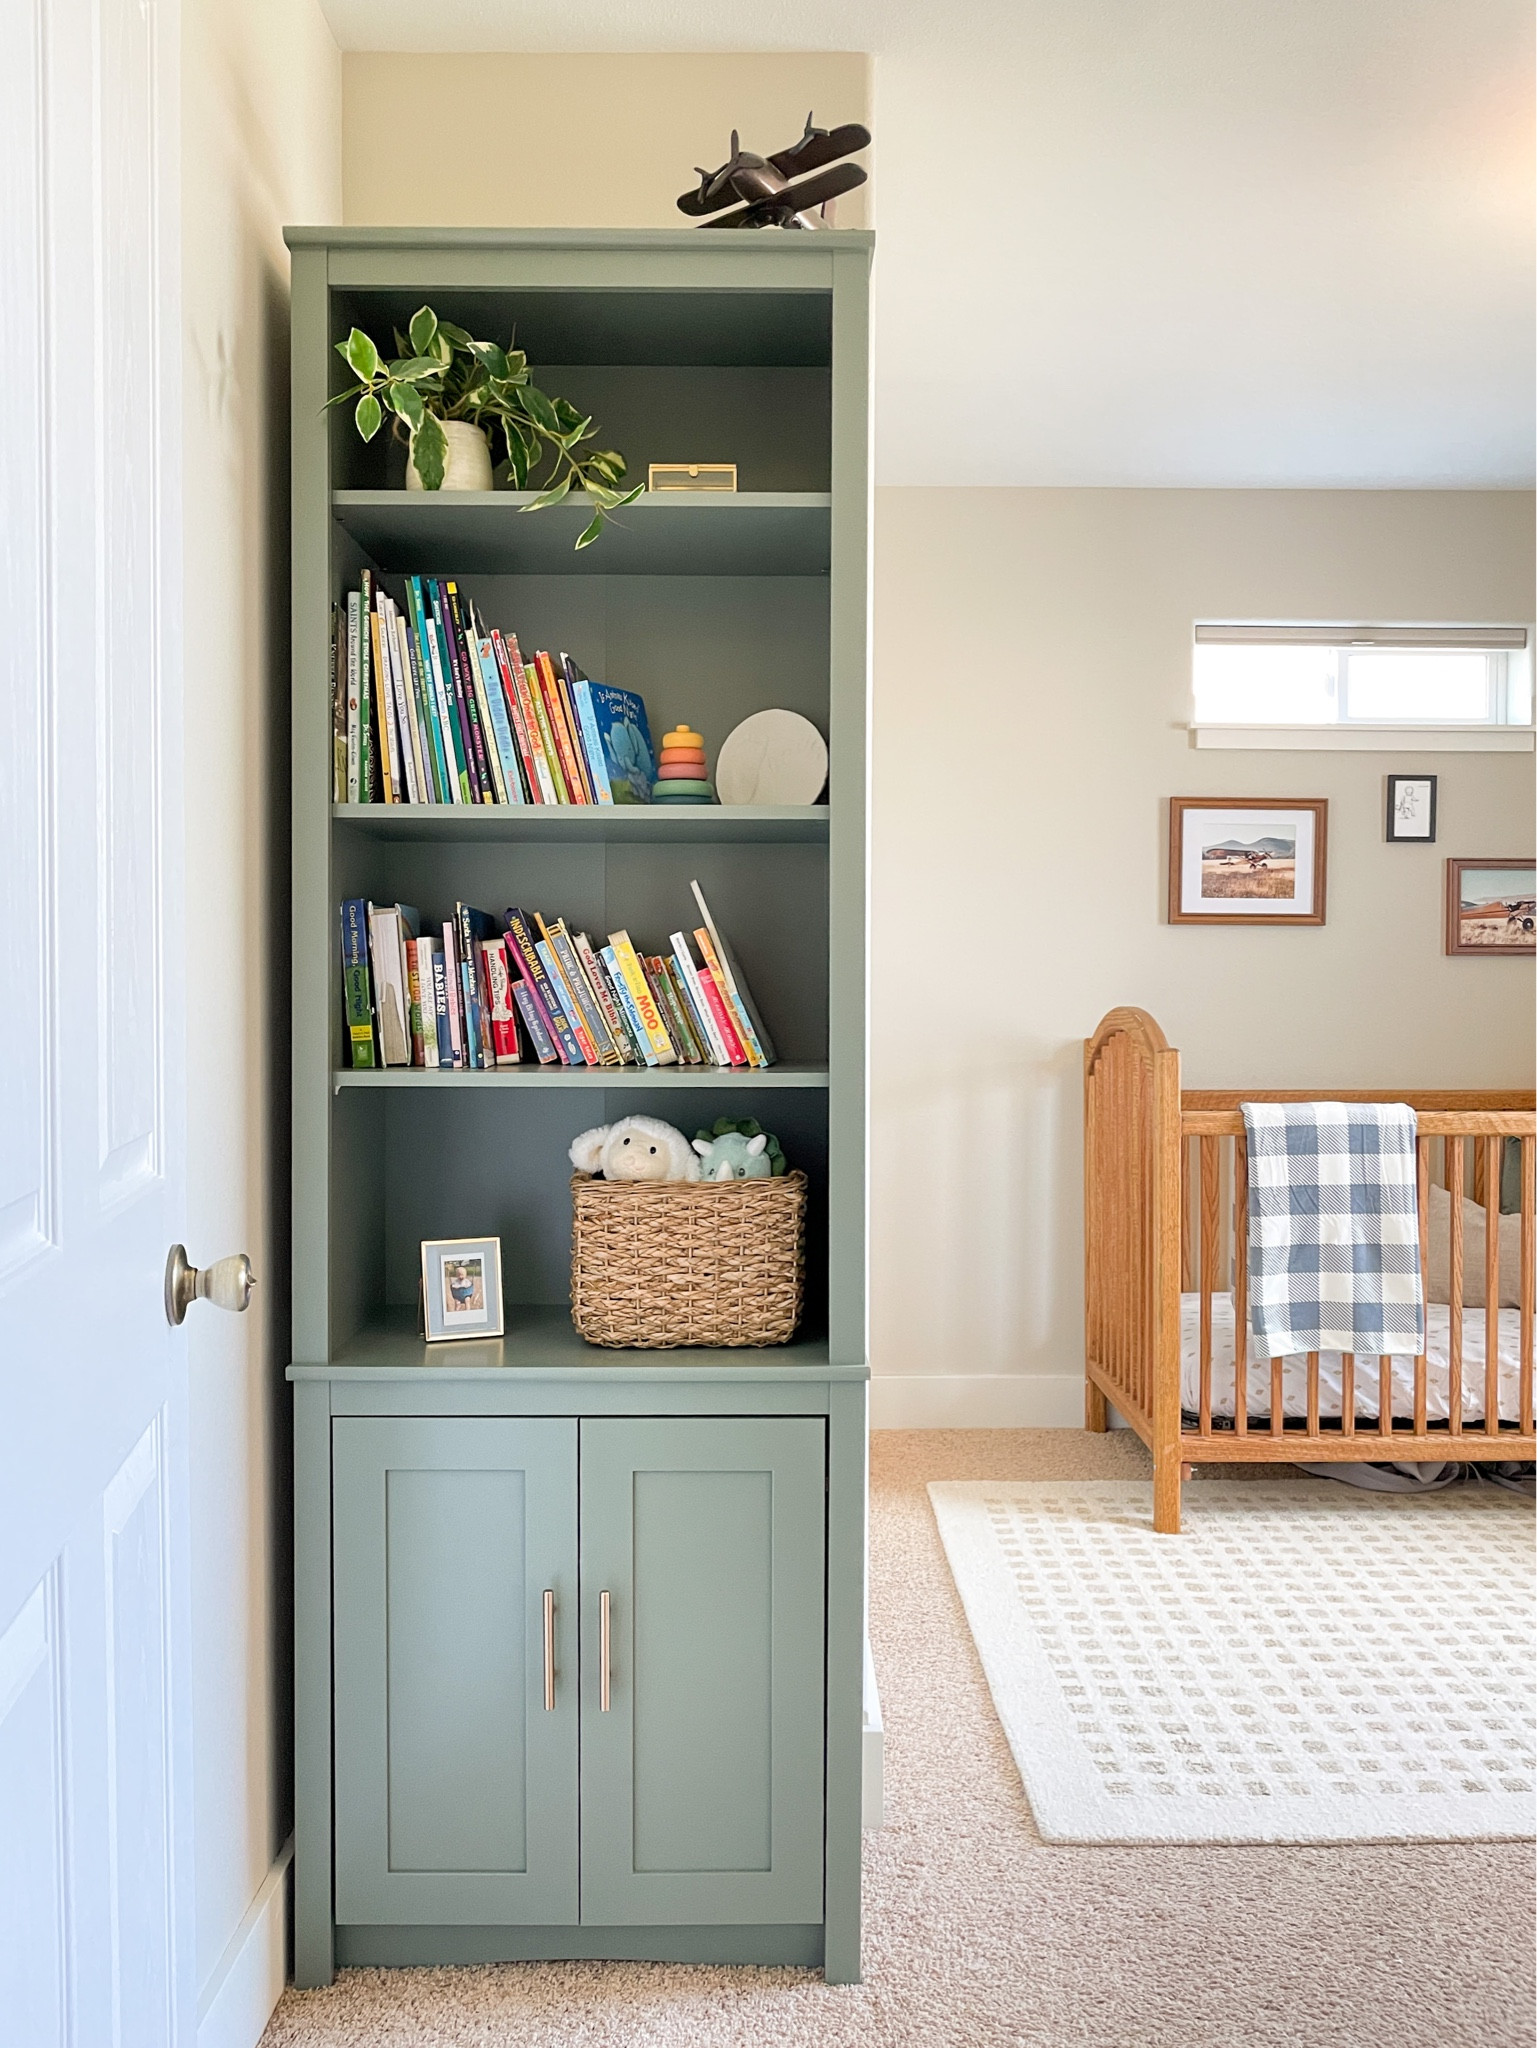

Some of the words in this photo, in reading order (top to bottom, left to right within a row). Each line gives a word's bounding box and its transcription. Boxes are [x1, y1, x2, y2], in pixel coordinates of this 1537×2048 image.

[350, 602, 358, 634] SAINTS
[350, 635, 358, 656] Around
[461, 651, 467, 662] GO
[362, 663, 370, 700] CHRISTMAS
[398, 702, 407, 715] You
[469, 698, 478, 723] GREEN
[492, 698, 504, 724] Diddle
[362, 724, 370, 732] Dr.
[362, 732, 370, 746] Seuss
[473, 724, 484, 761] MONSTER!
[530, 730, 541, 748] God
[350, 905, 358, 928] Good
[351, 930, 359, 967] Morning,
[462, 917, 471, 938] Santa
[468, 967, 477, 996] Montana
[510, 919, 546, 982] INDESCRIBABLE
[489, 953, 499, 988] HANDLING
[560, 950, 574, 970] PRIDE
[572, 976, 593, 1012] PREJUDICE
[434, 964, 446, 1016] BABIES!
[583, 948, 594, 965] God
[590, 966, 602, 990] Loves
[600, 990, 609, 1002] Me
[606, 1004, 618, 1025] Bible
[354, 994, 363, 1018] Night
[414, 1003, 424, 1032] words
[448, 992, 456, 1015] Babies
[604, 975, 614, 990] Good
[610, 990, 622, 1006] Night
[618, 1008, 634, 1038] Minnesota
[636, 995, 658, 1030] MOO
[531, 1020, 544, 1042] Spider
